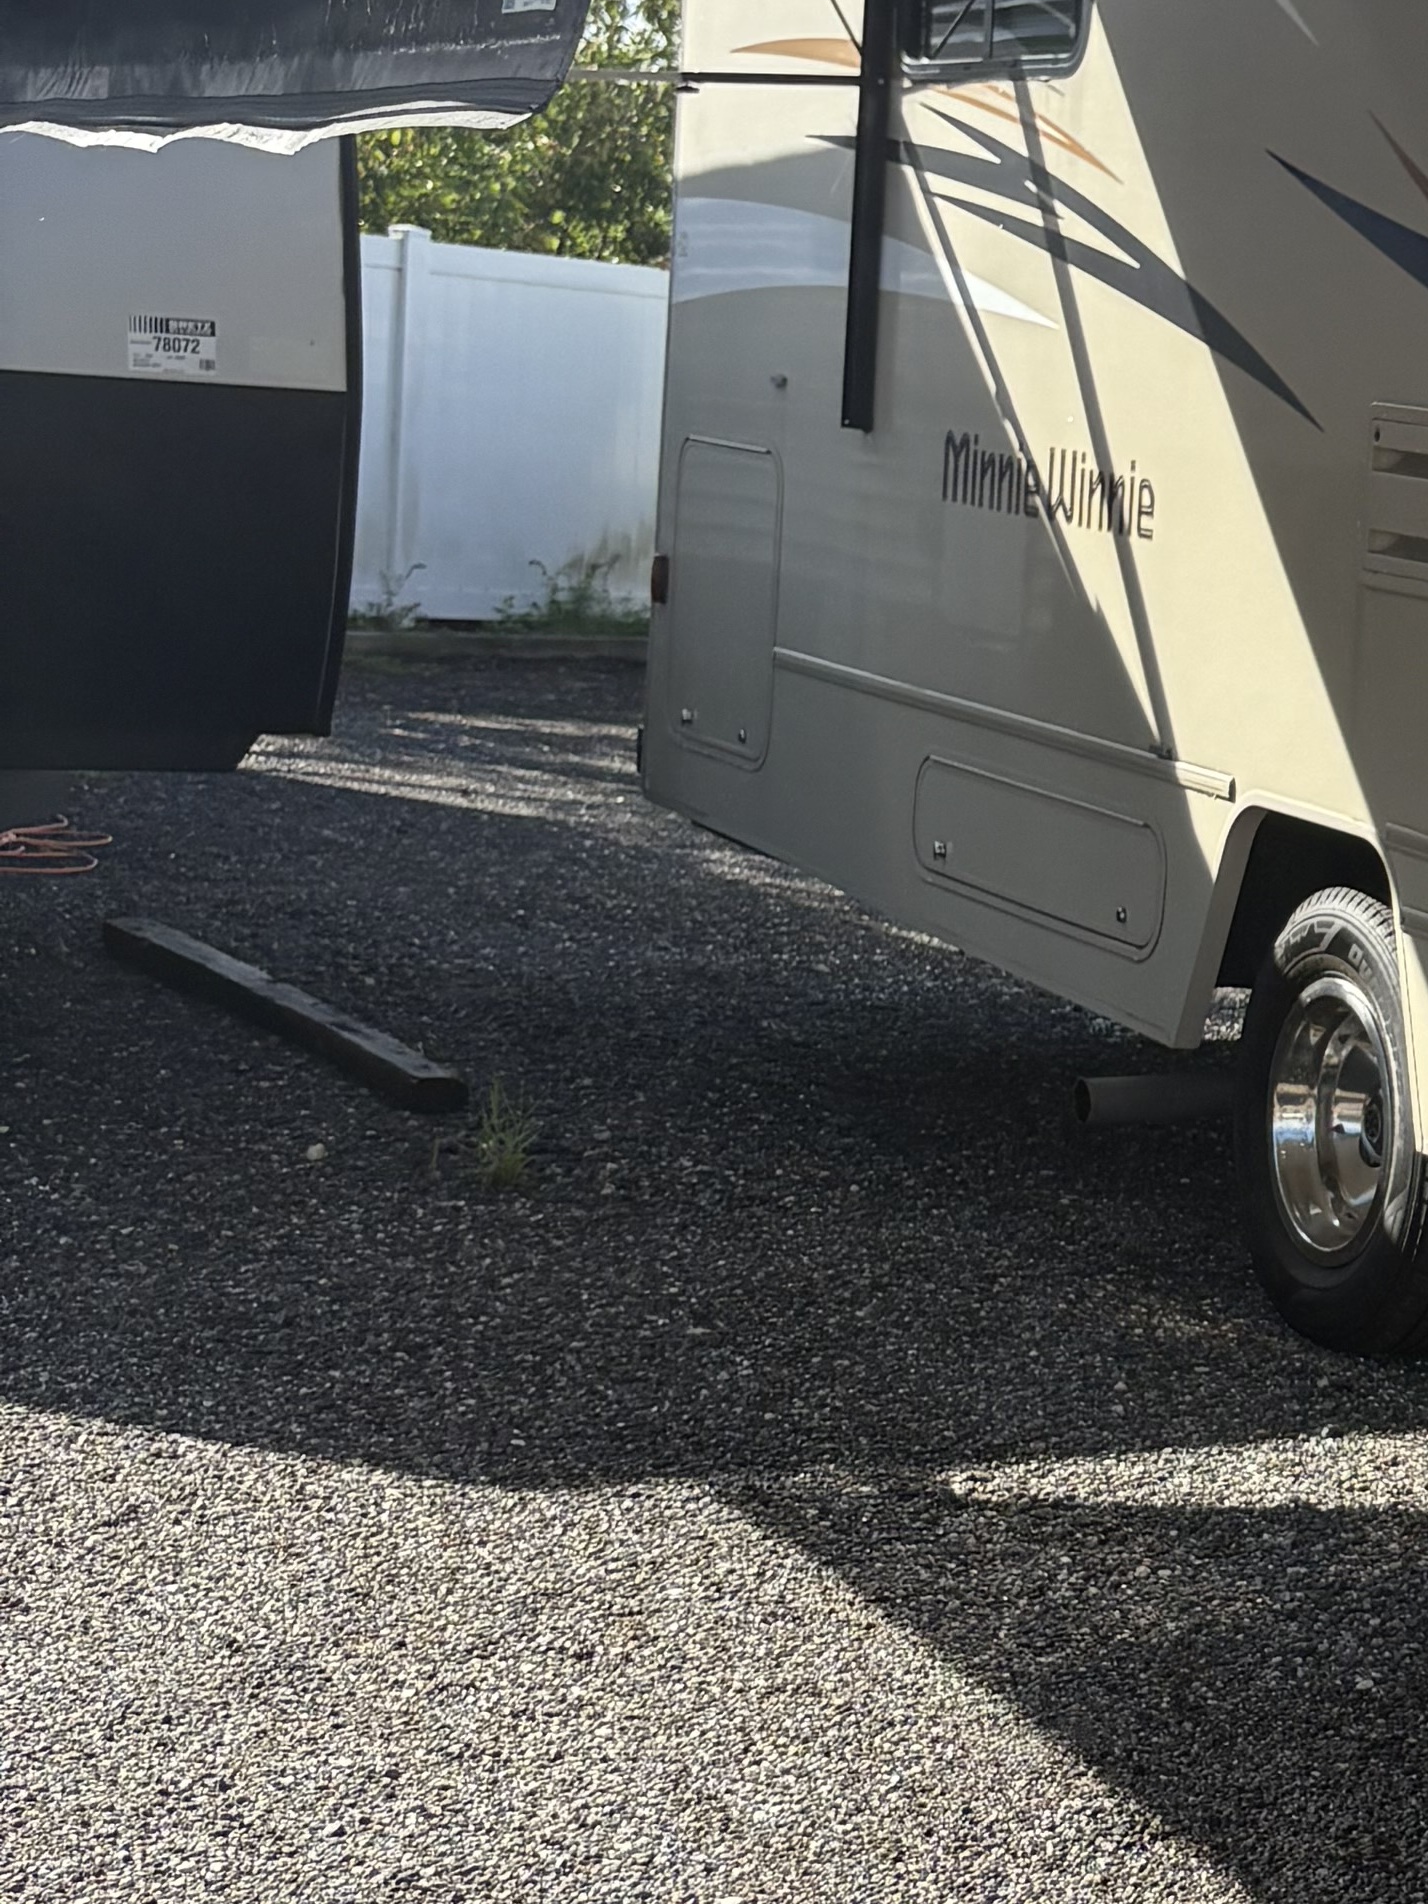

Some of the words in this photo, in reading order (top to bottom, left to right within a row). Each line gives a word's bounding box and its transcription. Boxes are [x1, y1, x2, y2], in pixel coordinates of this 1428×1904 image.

[152, 336, 201, 355] 78072
[942, 429, 1040, 518] Minnie
[1048, 447, 1155, 541] Winnie
